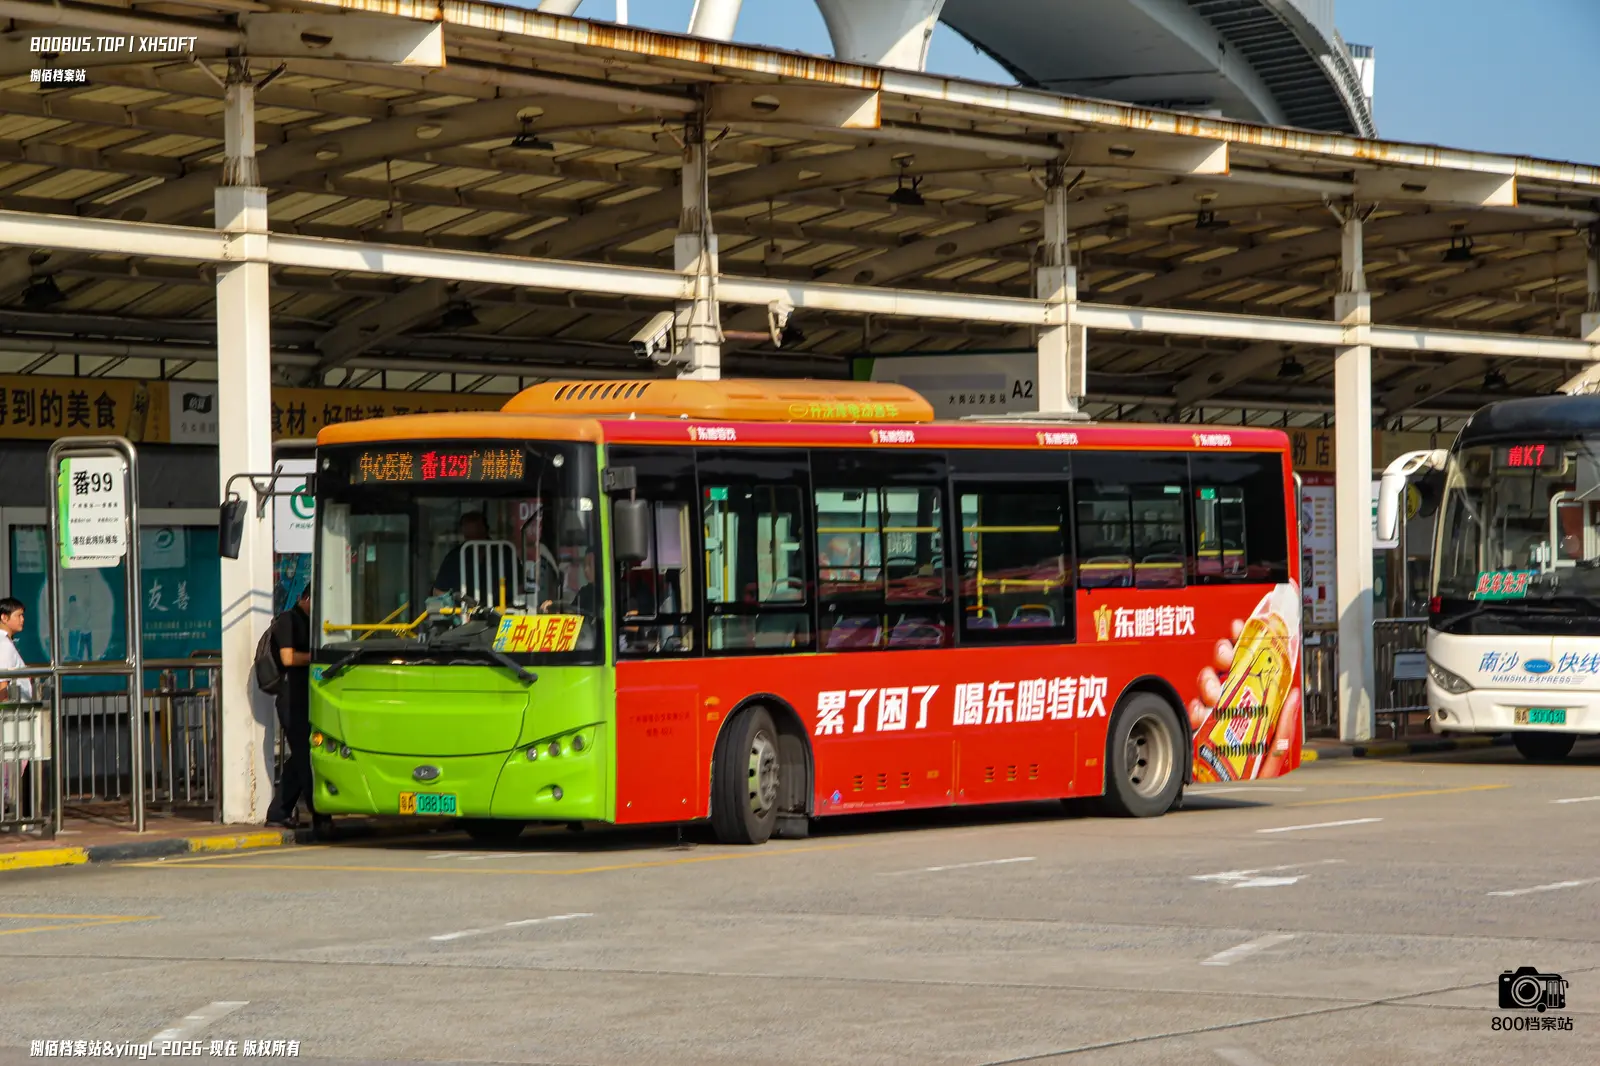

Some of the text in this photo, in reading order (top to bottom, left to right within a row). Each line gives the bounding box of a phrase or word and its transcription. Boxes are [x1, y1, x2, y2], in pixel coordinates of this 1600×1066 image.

[1011, 379, 1034, 399] A2
[1292, 431, 1331, 467] 粉店
[1508, 444, 1546, 466] 南K7
[359, 449, 524, 481] 中心医院 番129 广州南站
[73, 470, 113, 495] 番99
[148, 578, 190, 612] 友善
[1477, 573, 1528, 594] 此车先开
[511, 616, 577, 652] 中心医院
[1114, 605, 1195, 638] 东鹏特饮
[1478, 651, 1600, 674] 南沙 快线
[1492, 674, 1572, 685] NANSHA EXPRESS
[815, 674, 1108, 736] 累了困了 喝东鹏特饮
